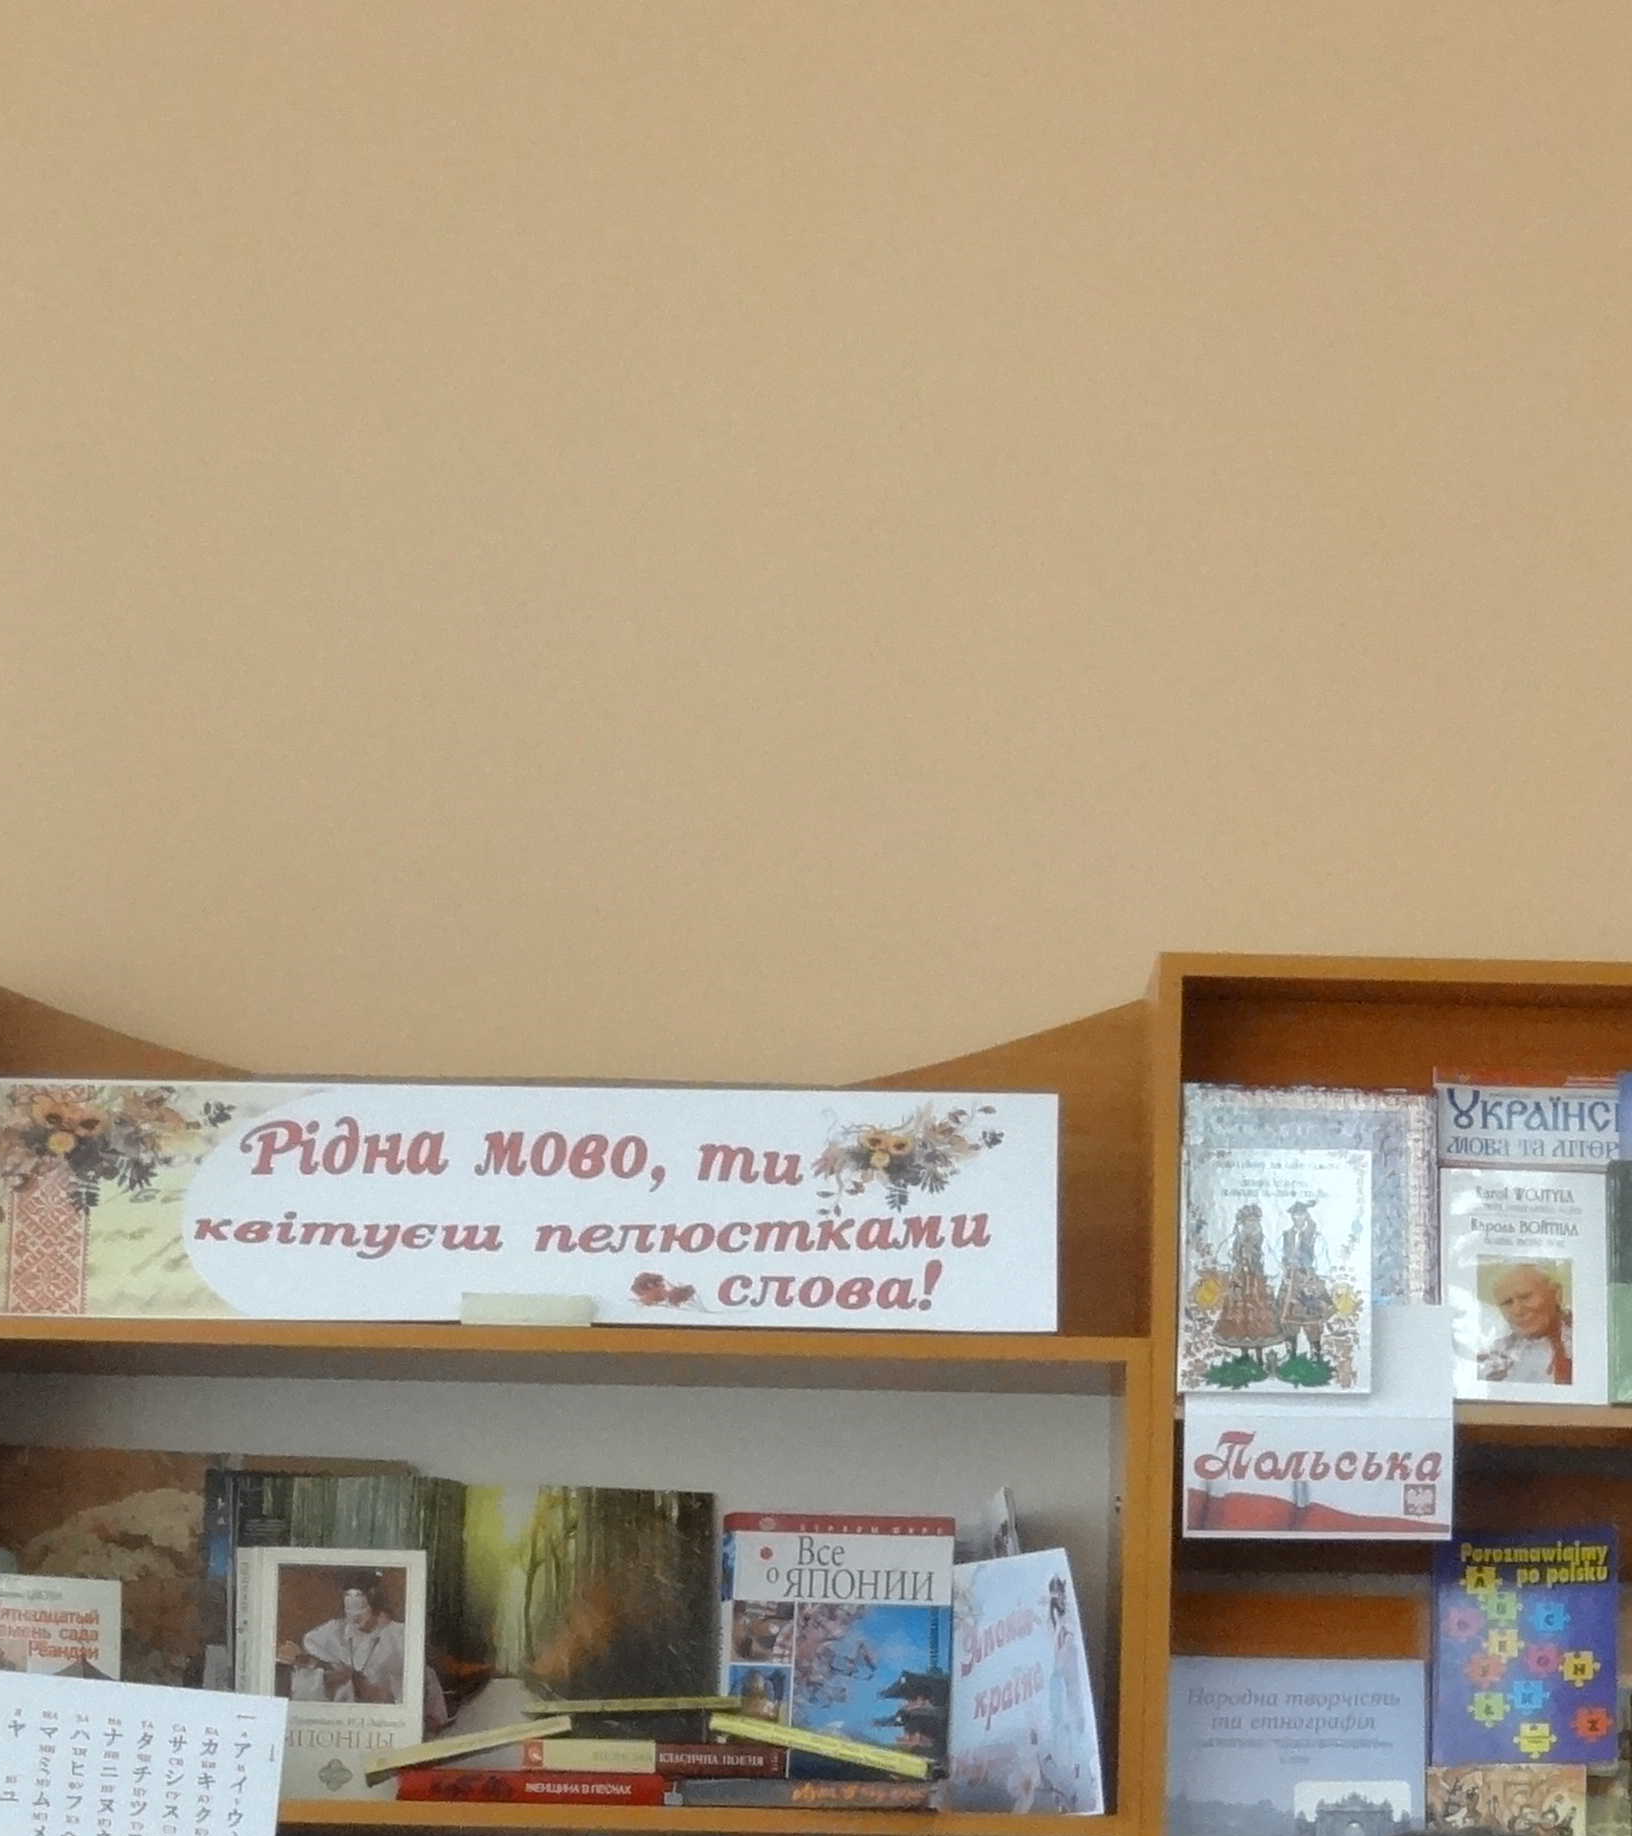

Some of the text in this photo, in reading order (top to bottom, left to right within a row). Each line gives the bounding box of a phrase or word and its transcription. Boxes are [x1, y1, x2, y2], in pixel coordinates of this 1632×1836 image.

[239, 1115, 806, 1193] Рідна мово, ти
[193, 1205, 993, 1259] квітуєш пелюстками
[716, 1258, 946, 1312] слова!
[1193, 1430, 1443, 1481] Польська
[797, 1535, 846, 1566] Все
[766, 1567, 935, 1601] о ЯПОНИИ
[1517, 1563, 1609, 1589] po polsku
[58, 1628, 99, 1642] сада
[1186, 1687, 1401, 1712] Народна творчість
[1211, 1716, 1243, 1731] та
